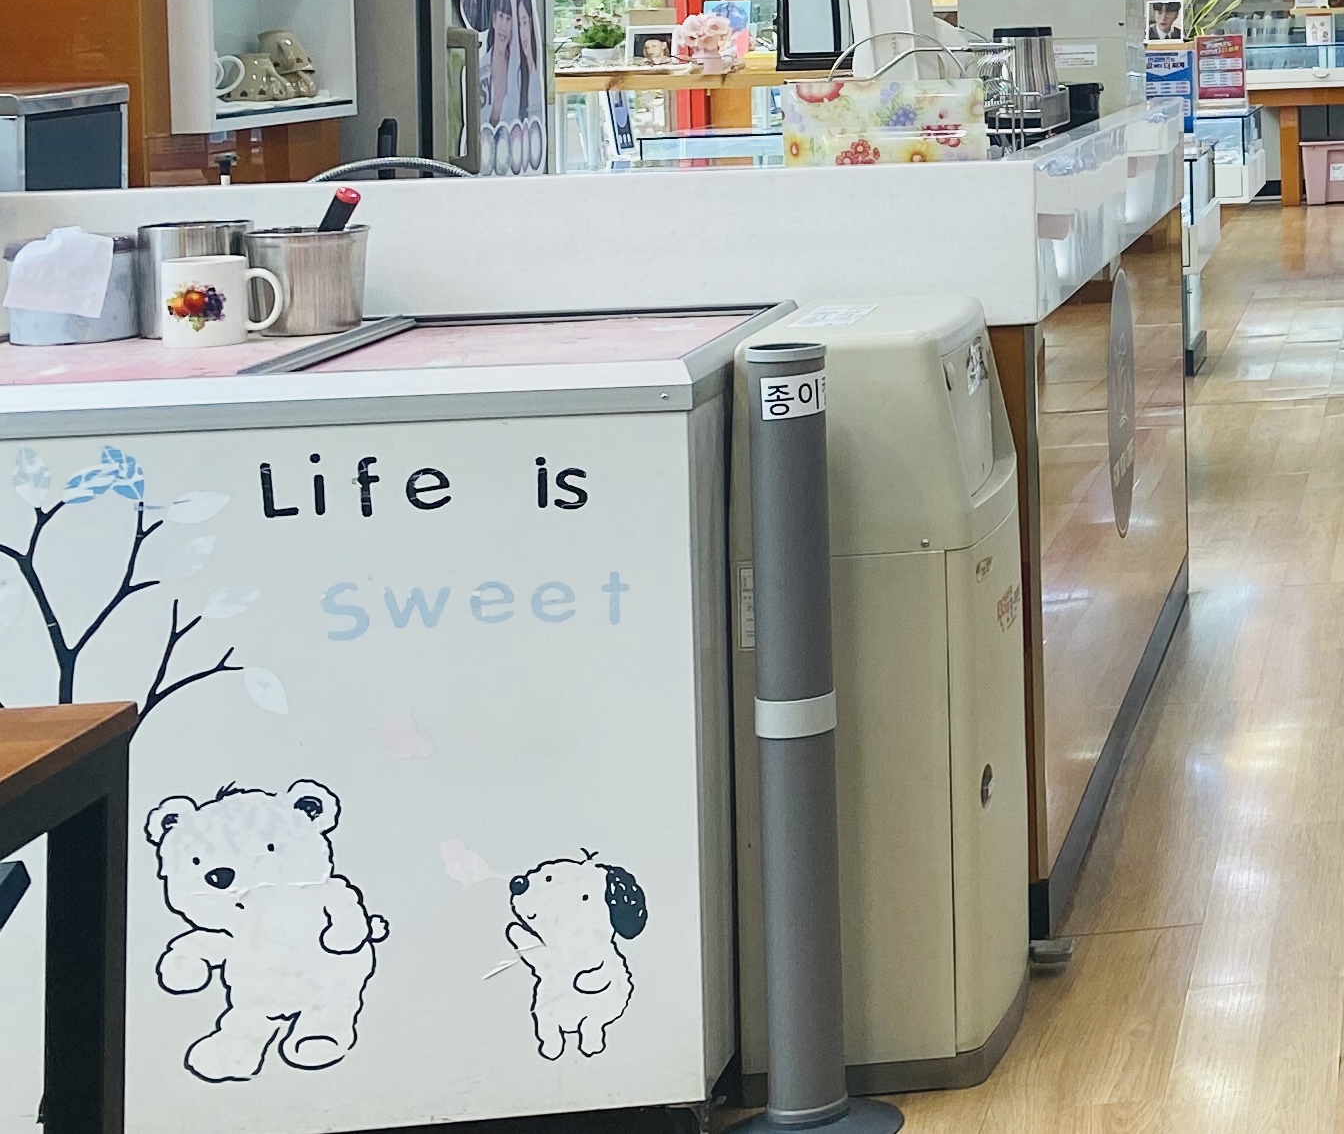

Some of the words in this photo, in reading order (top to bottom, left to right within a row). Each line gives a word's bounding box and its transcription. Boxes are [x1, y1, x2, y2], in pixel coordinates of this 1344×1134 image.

[764, 377, 827, 416] 종이
[260, 453, 452, 518] Life
[535, 456, 589, 510] is
[320, 571, 631, 641] sweet
